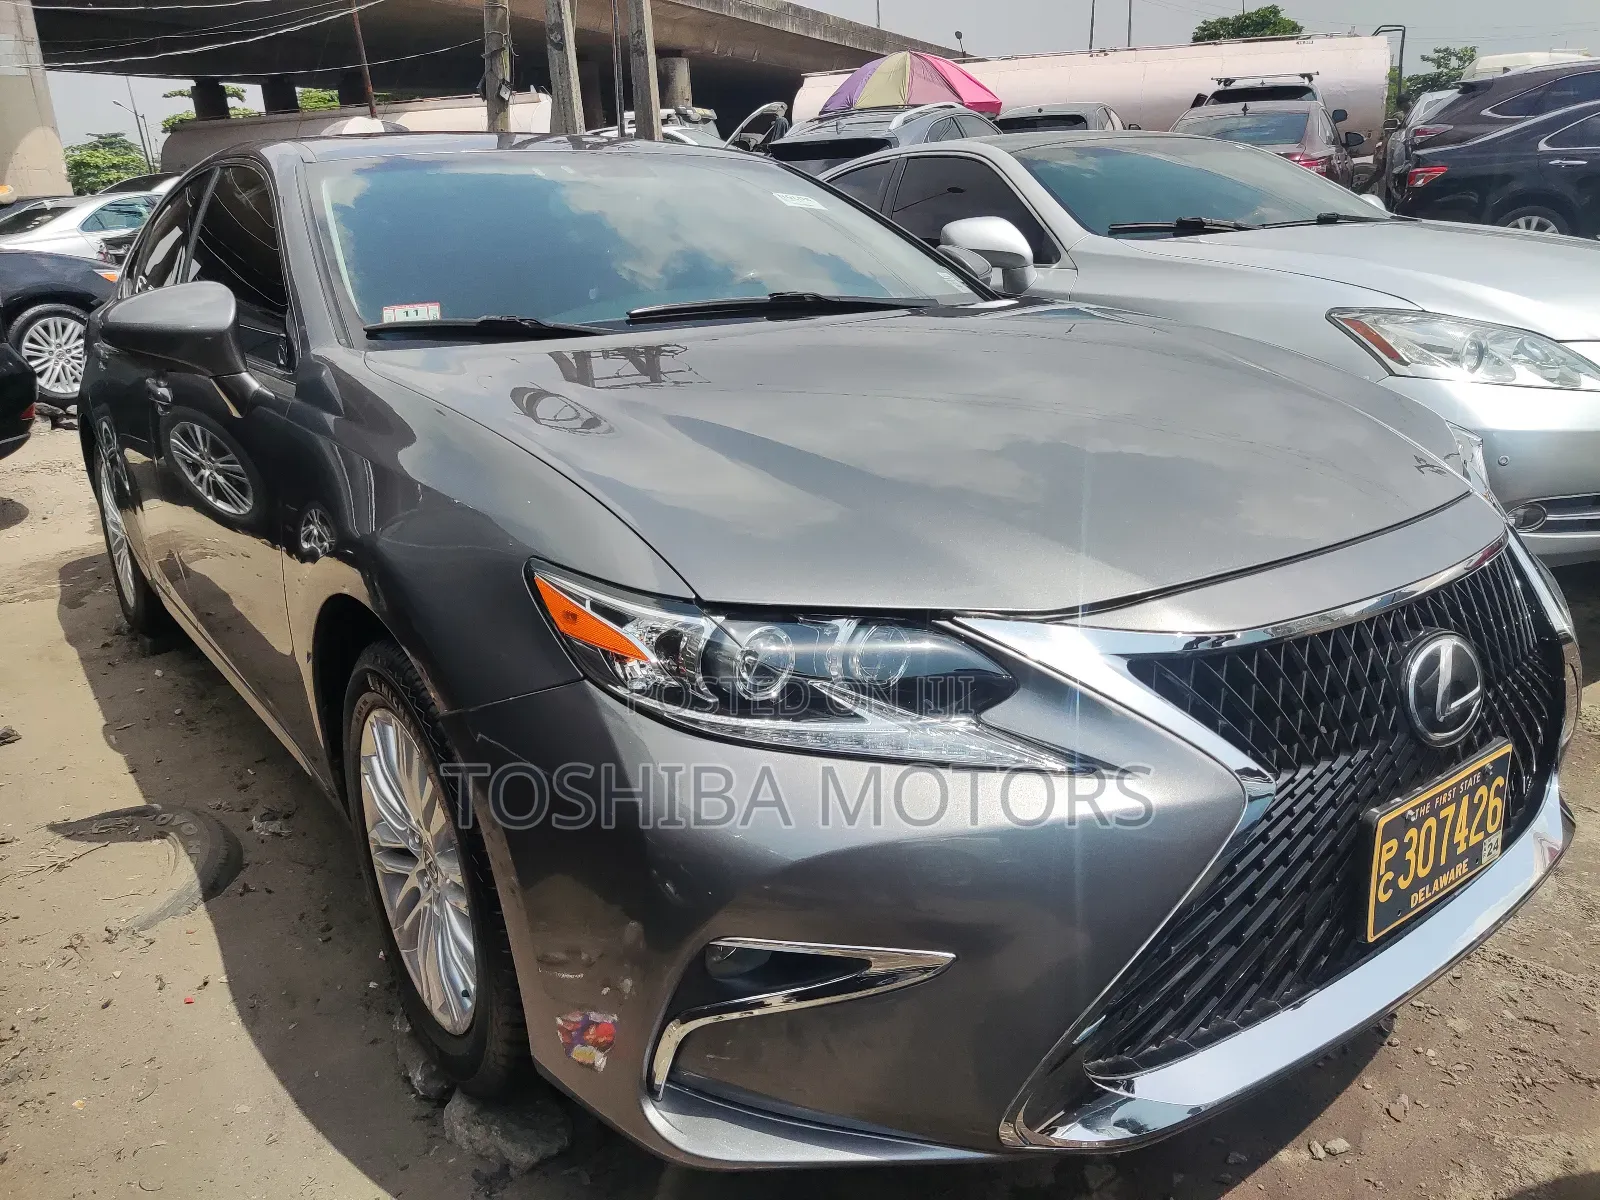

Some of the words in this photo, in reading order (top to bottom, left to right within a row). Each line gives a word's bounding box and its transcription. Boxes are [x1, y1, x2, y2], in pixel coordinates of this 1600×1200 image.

[1413, 801, 1431, 820] THE
[1434, 787, 1457, 811] FIRST
[1459, 773, 1482, 795] STATE
[1397, 775, 1505, 890] 307426
[1410, 857, 1469, 909] DELAWARE
